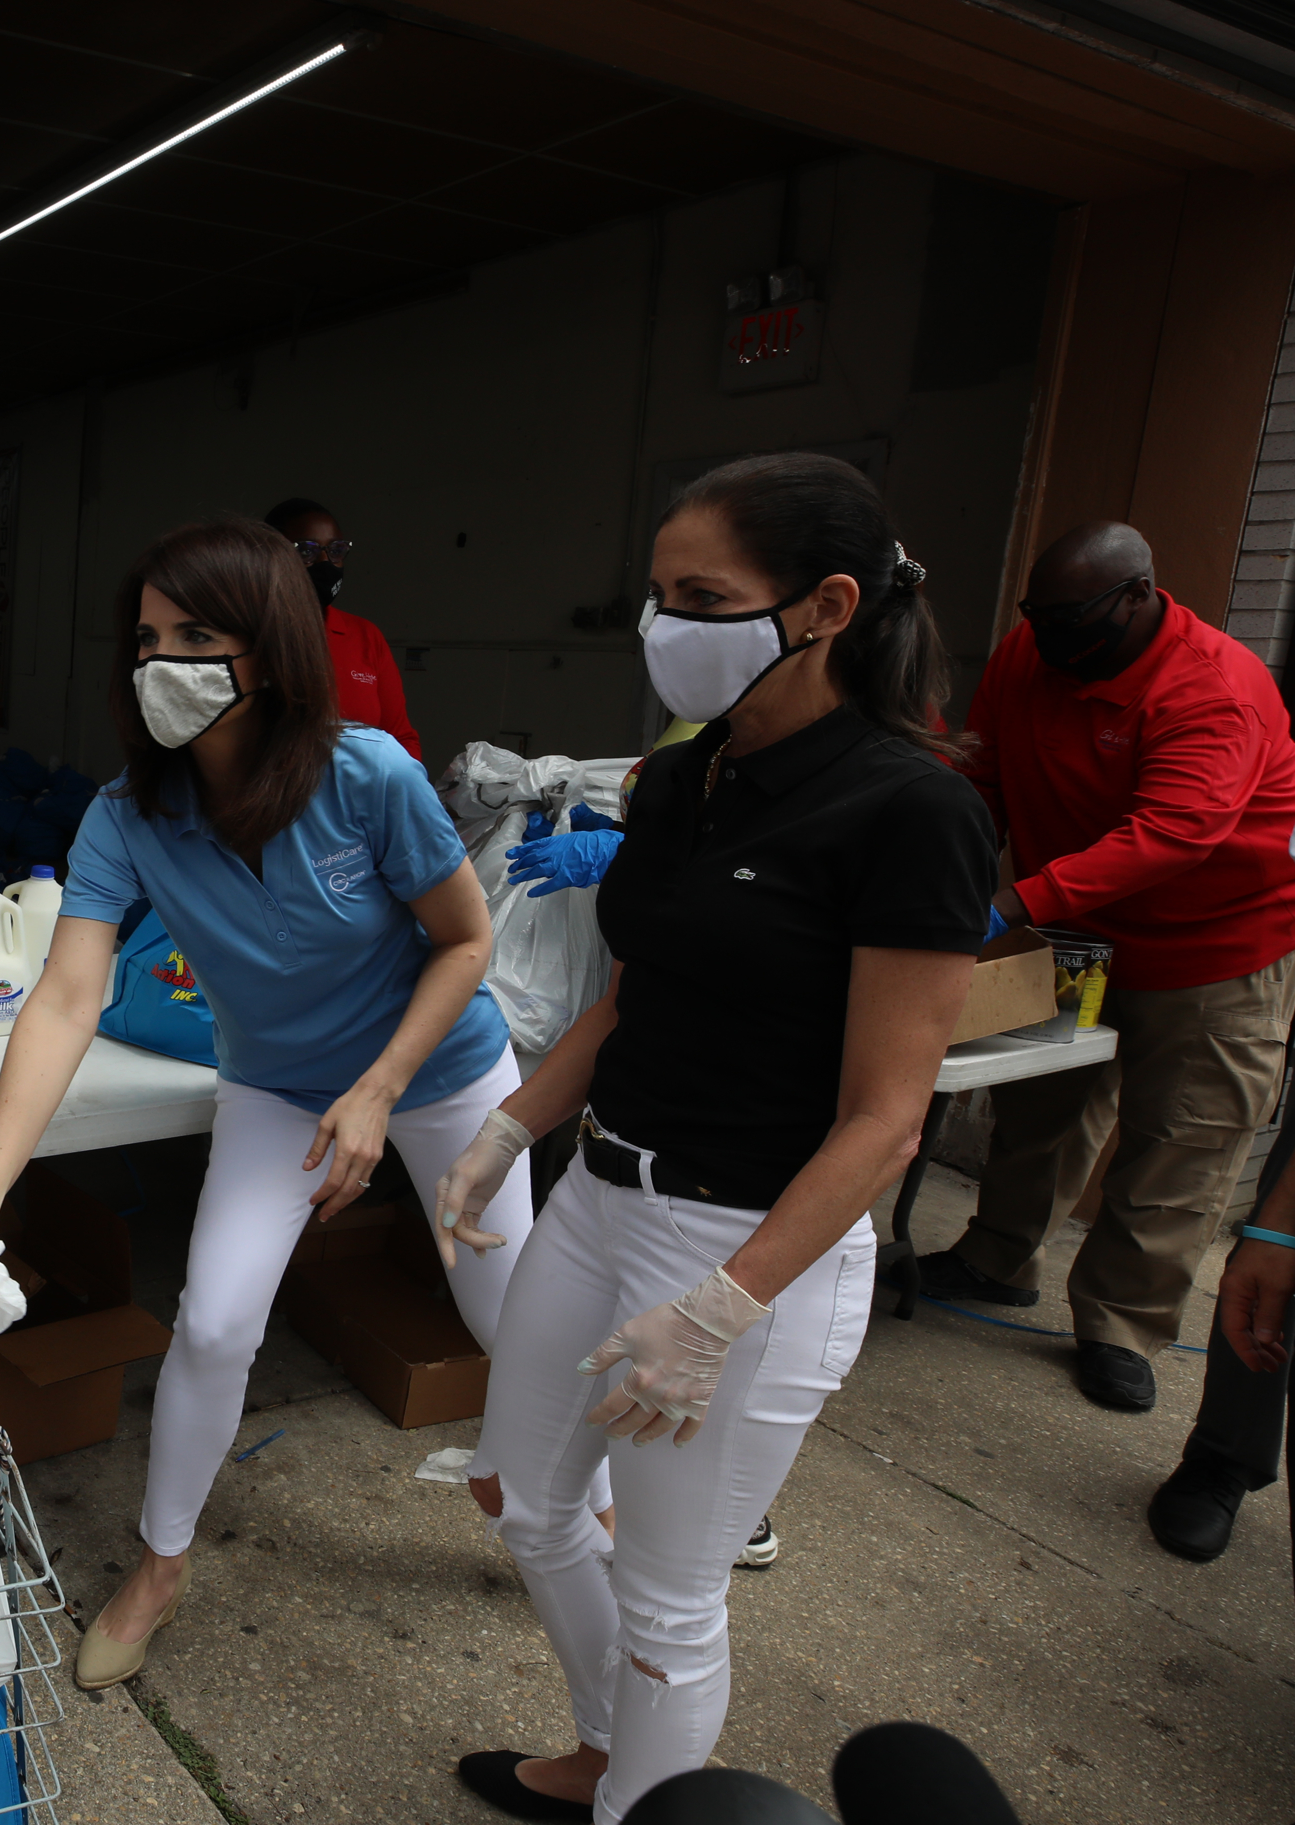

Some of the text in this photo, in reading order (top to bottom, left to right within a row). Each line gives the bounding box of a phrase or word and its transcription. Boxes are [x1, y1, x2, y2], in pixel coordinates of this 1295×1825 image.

[737, 306, 800, 364] EXIT
[312, 844, 363, 868] LogistiCare
[1056, 956, 1085, 966] TRAIL
[151, 963, 196, 989] Action
[170, 989, 199, 1002] INC.
